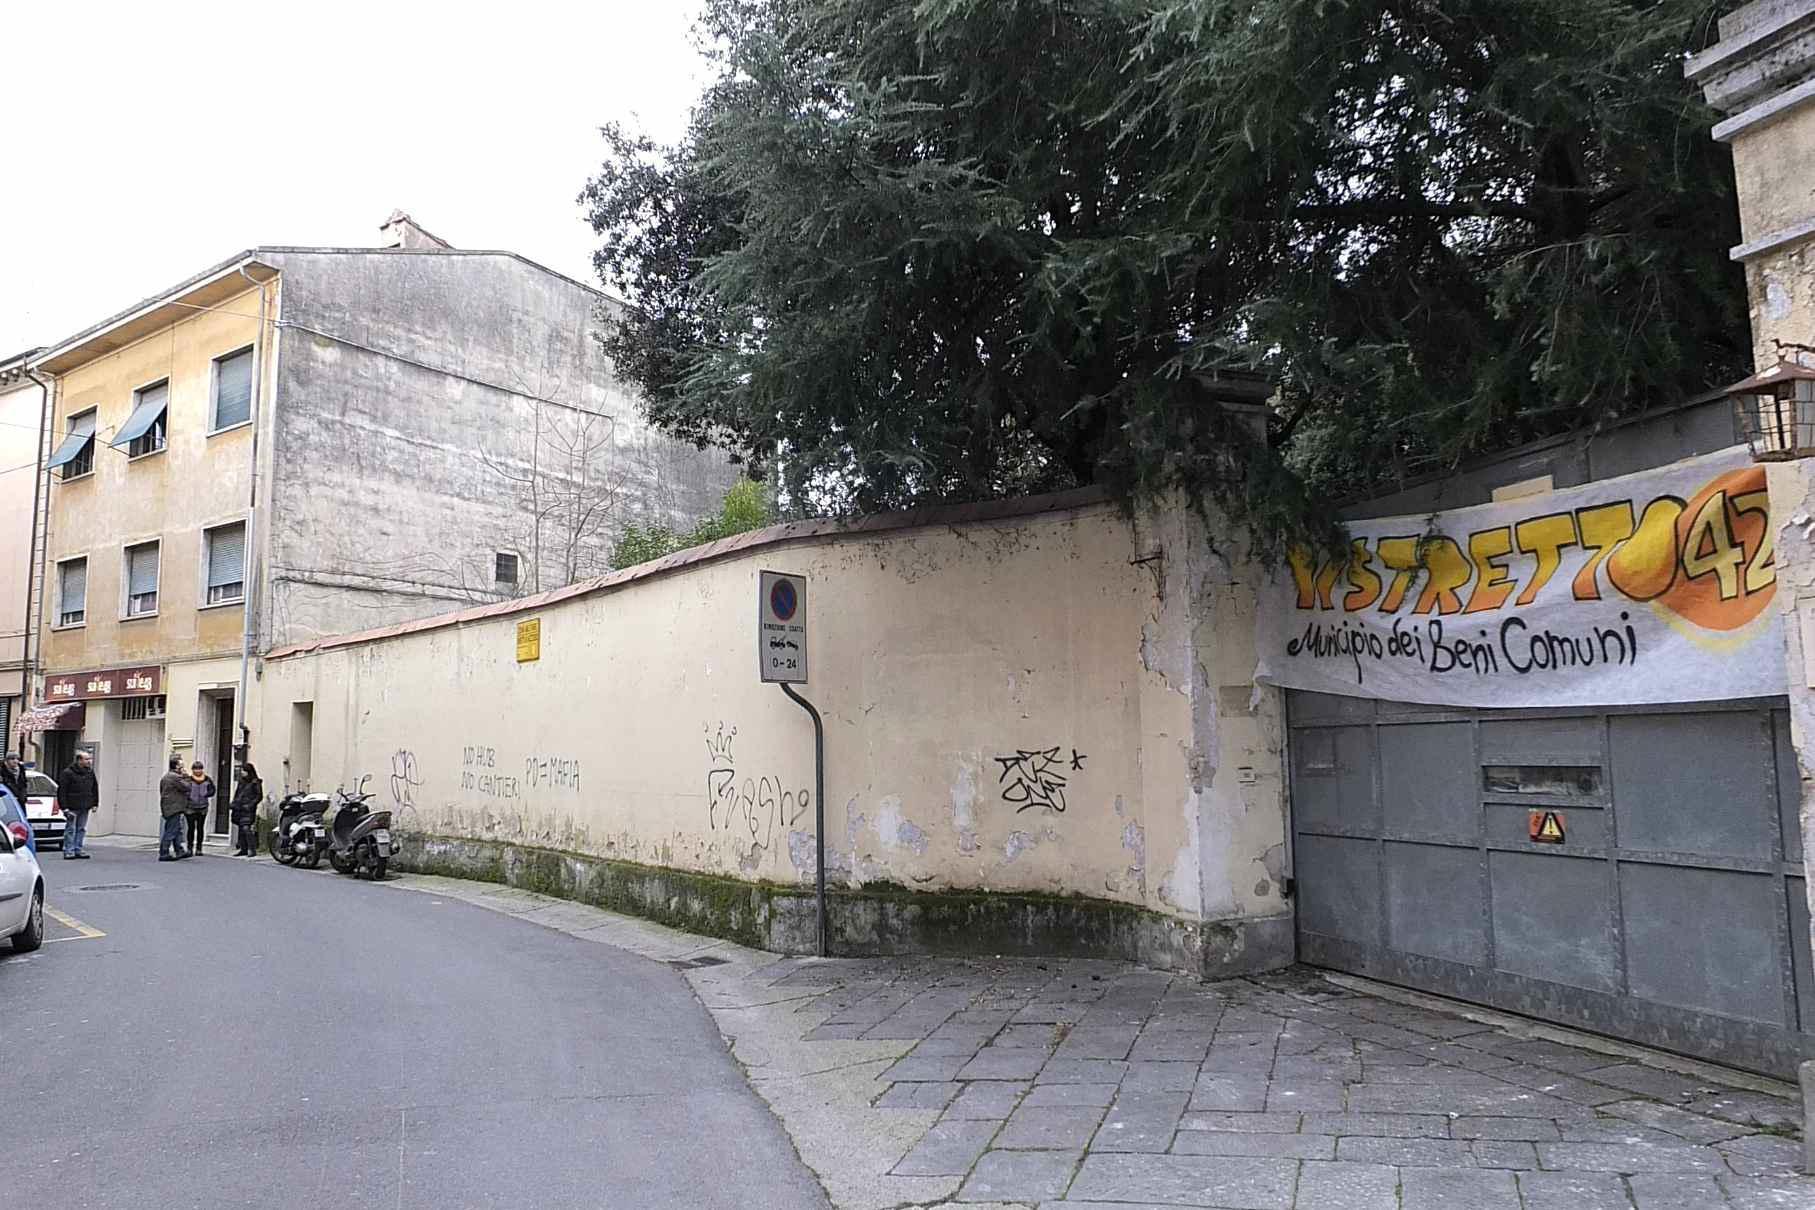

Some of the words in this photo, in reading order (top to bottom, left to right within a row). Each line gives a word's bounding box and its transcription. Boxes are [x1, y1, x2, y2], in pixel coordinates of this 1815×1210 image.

[1681, 488, 1777, 602] 42
[1287, 620, 1383, 684] Municipio
[1388, 617, 1425, 664] dei
[1428, 618, 1499, 674] Beni
[1500, 611, 1637, 674] Comuni
[462, 746, 475, 766] NO
[461, 770, 475, 790] NO
